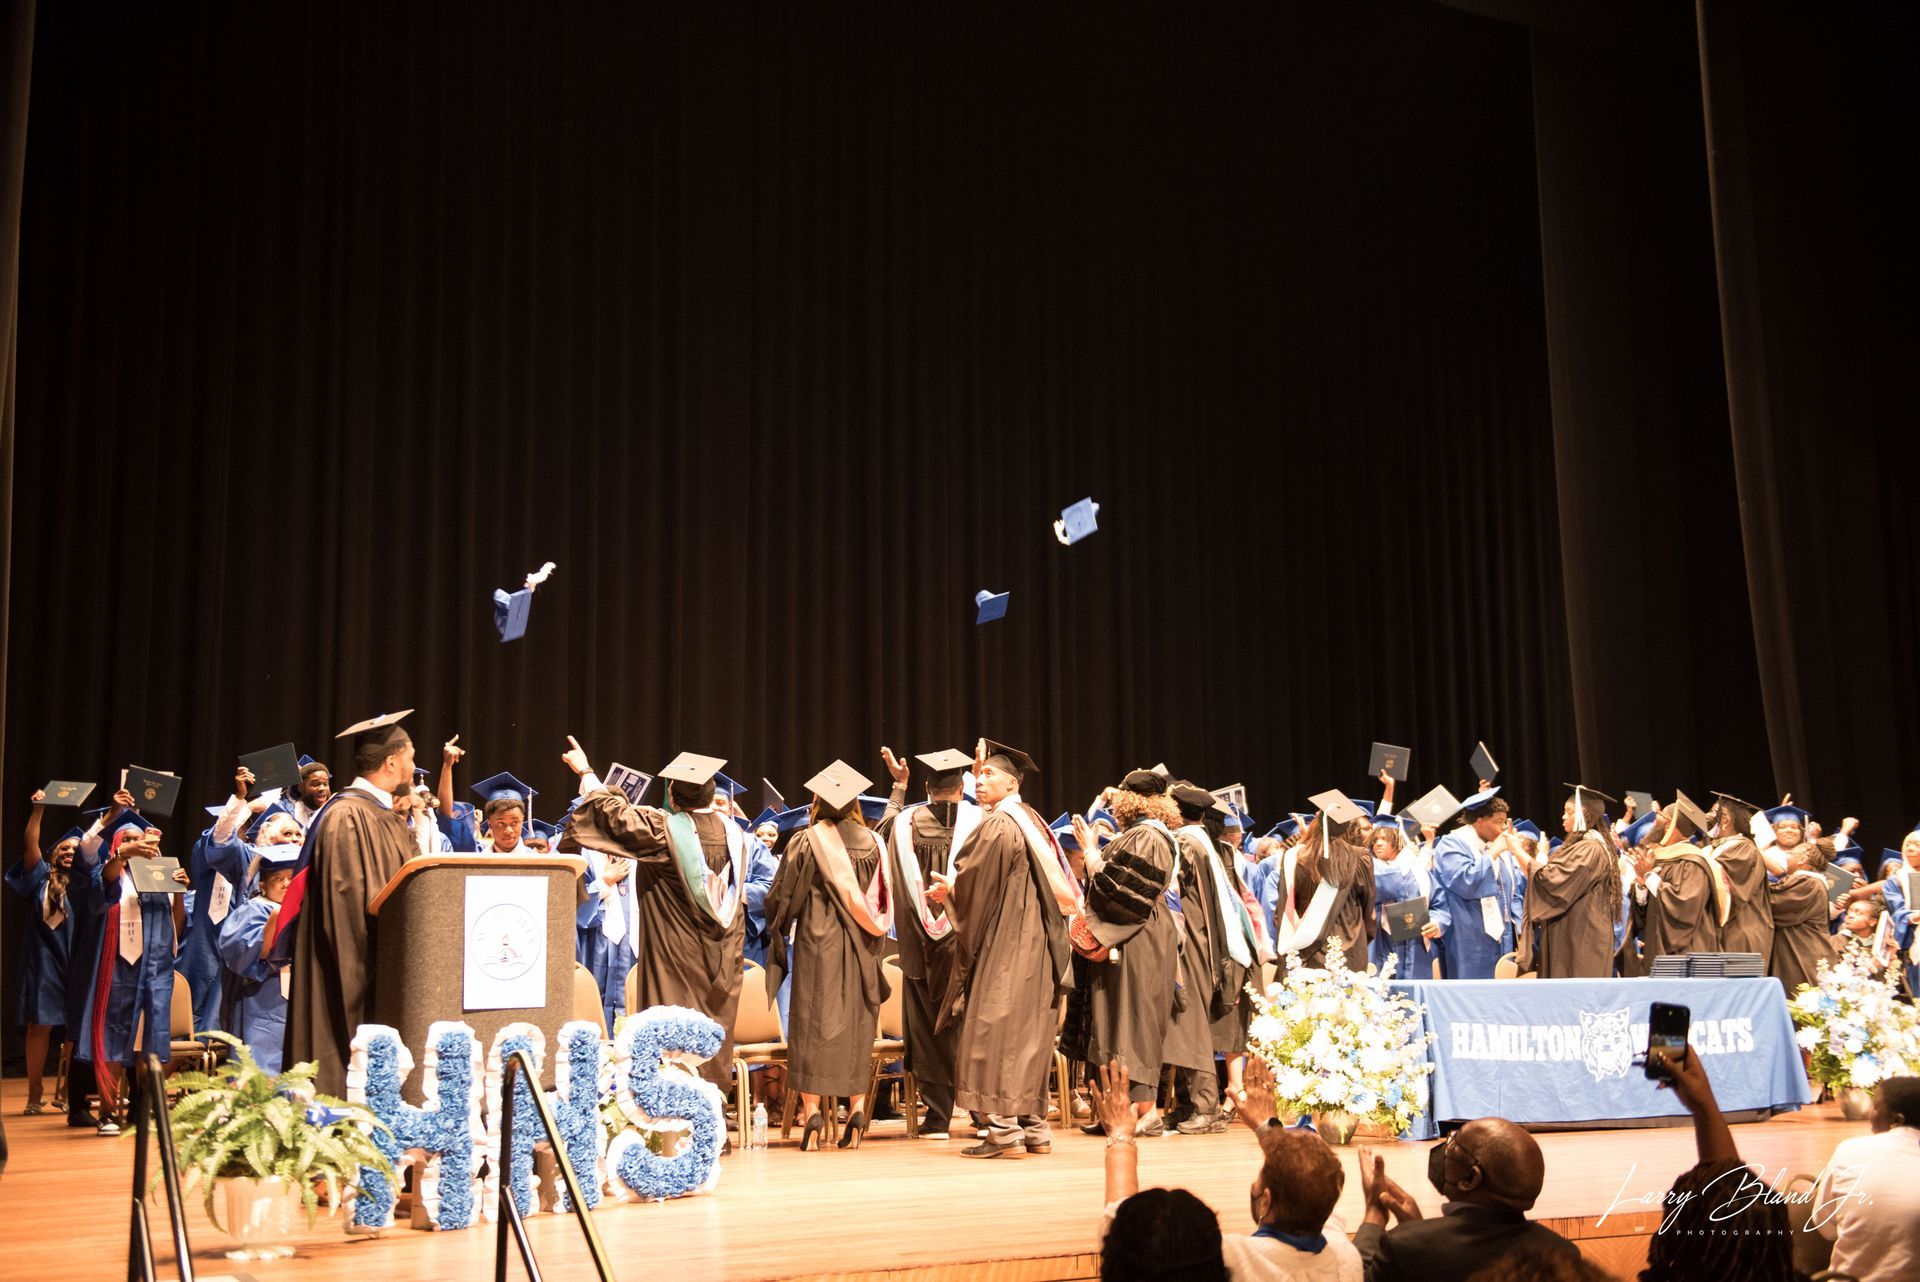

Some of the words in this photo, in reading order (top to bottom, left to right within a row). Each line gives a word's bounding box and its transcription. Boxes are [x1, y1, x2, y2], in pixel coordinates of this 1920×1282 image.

[1450, 1021, 1583, 1062] HAMILTON
[1629, 1017, 1754, 1059] WCATS
[344, 1004, 727, 1236] HHS
